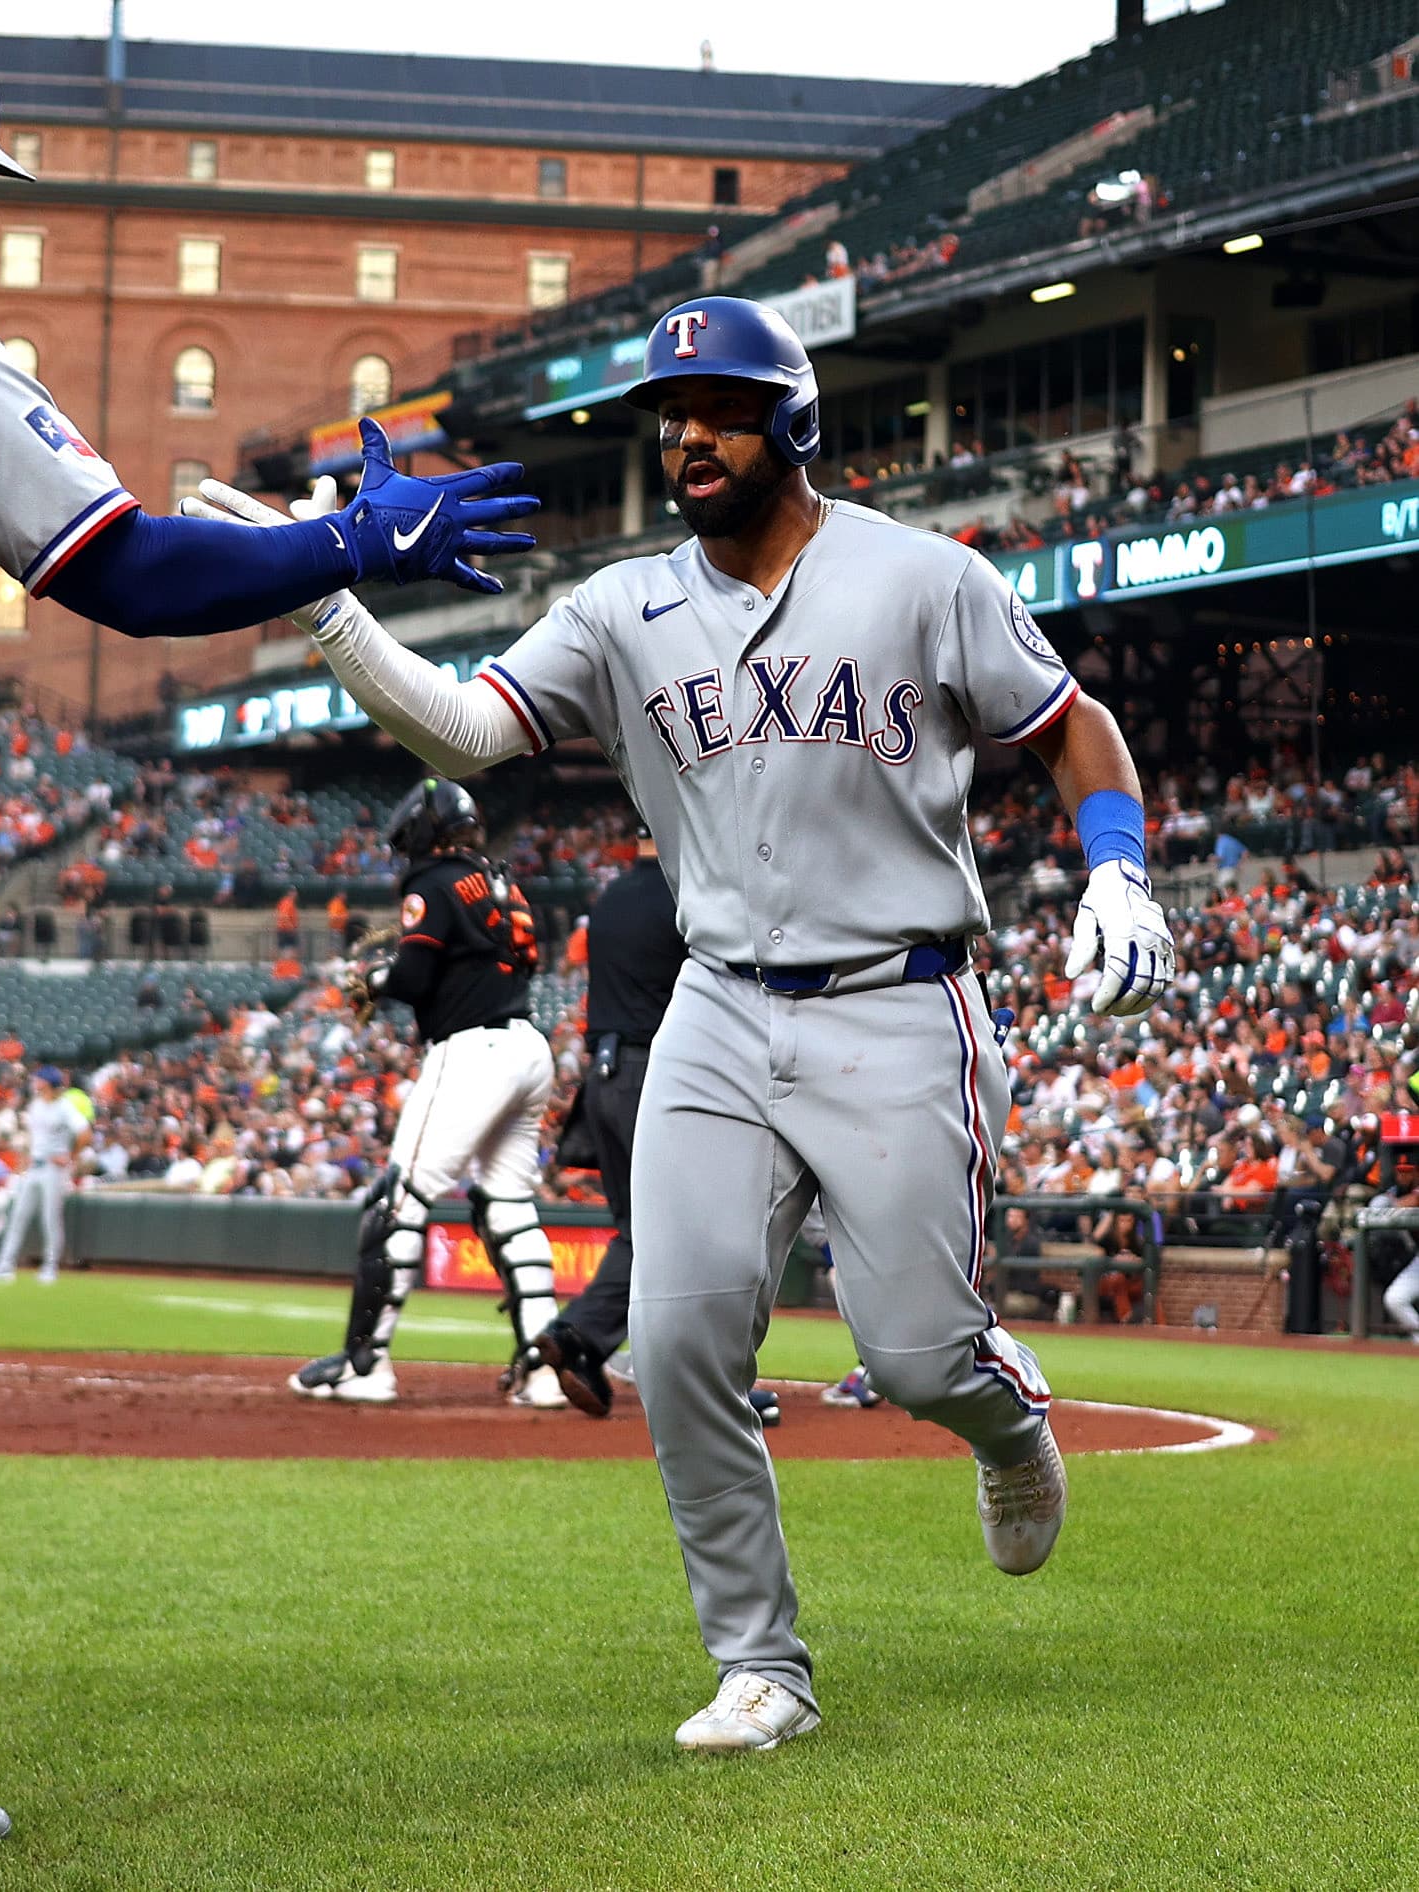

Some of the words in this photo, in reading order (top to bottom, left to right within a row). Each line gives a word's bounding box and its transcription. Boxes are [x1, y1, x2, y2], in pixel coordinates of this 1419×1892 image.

[666, 310, 707, 358] T
[1117, 526, 1224, 587] NIMMO
[643, 655, 923, 773] TEXAS
